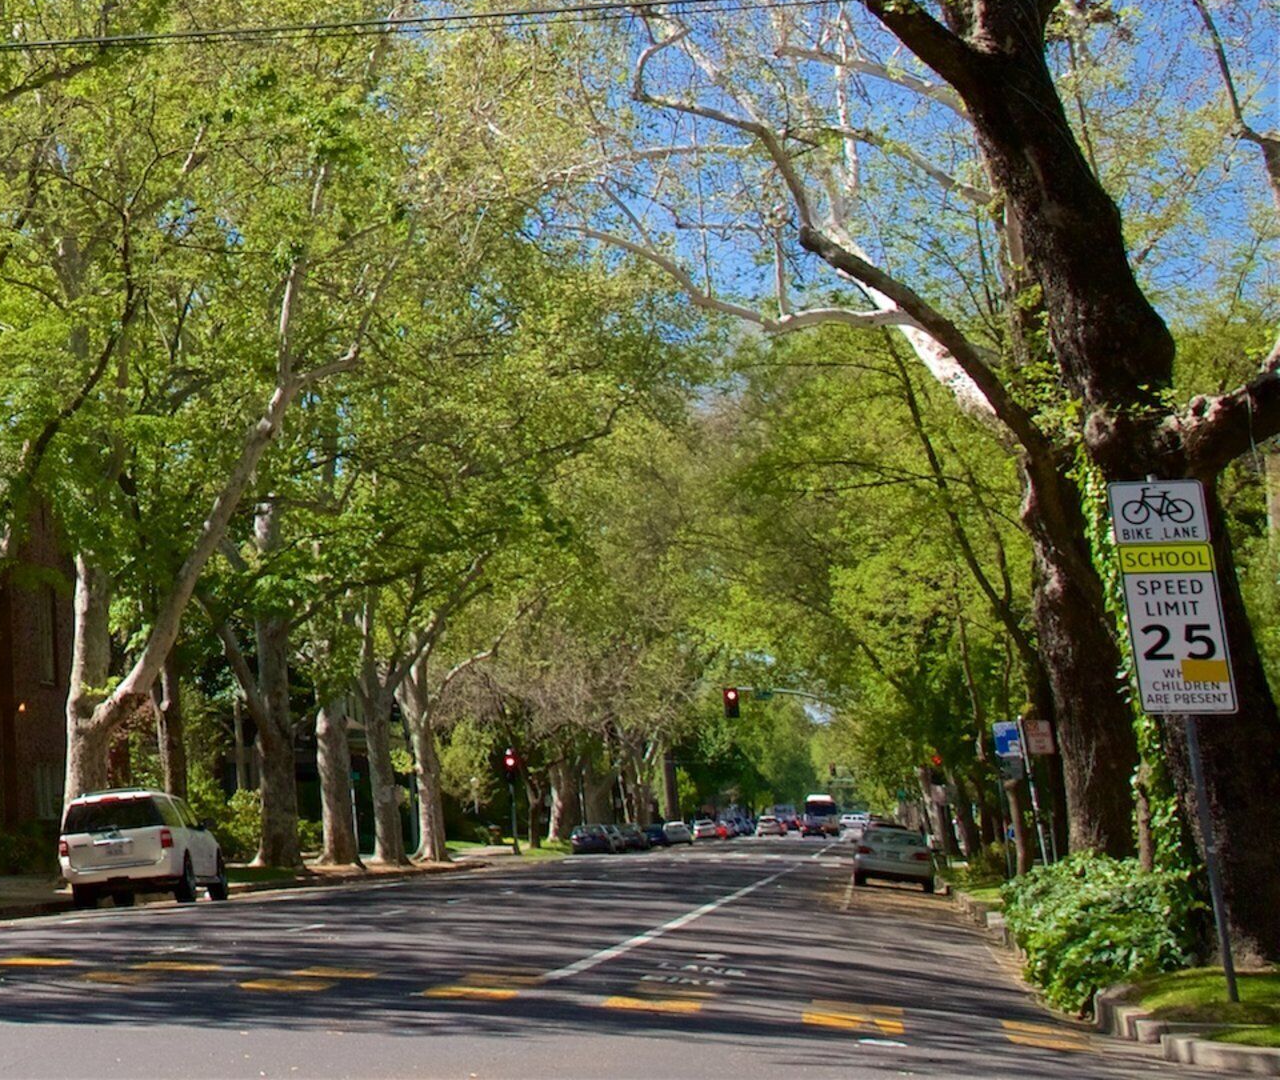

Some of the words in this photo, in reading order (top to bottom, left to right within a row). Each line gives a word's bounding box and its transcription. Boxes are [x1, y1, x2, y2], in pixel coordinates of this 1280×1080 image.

[1122, 528, 1152, 540] BIKE
[1163, 526, 1198, 539] LANE
[1125, 551, 1208, 567] SCHOOL
[1137, 579, 1203, 595] SPEED
[1145, 601, 1199, 616] LIMIT
[1141, 624, 1216, 660] 25
[1152, 681, 1220, 691] CHILDREN
[1147, 693, 1170, 704] ARE
[1174, 693, 1228, 705] PRESENT
